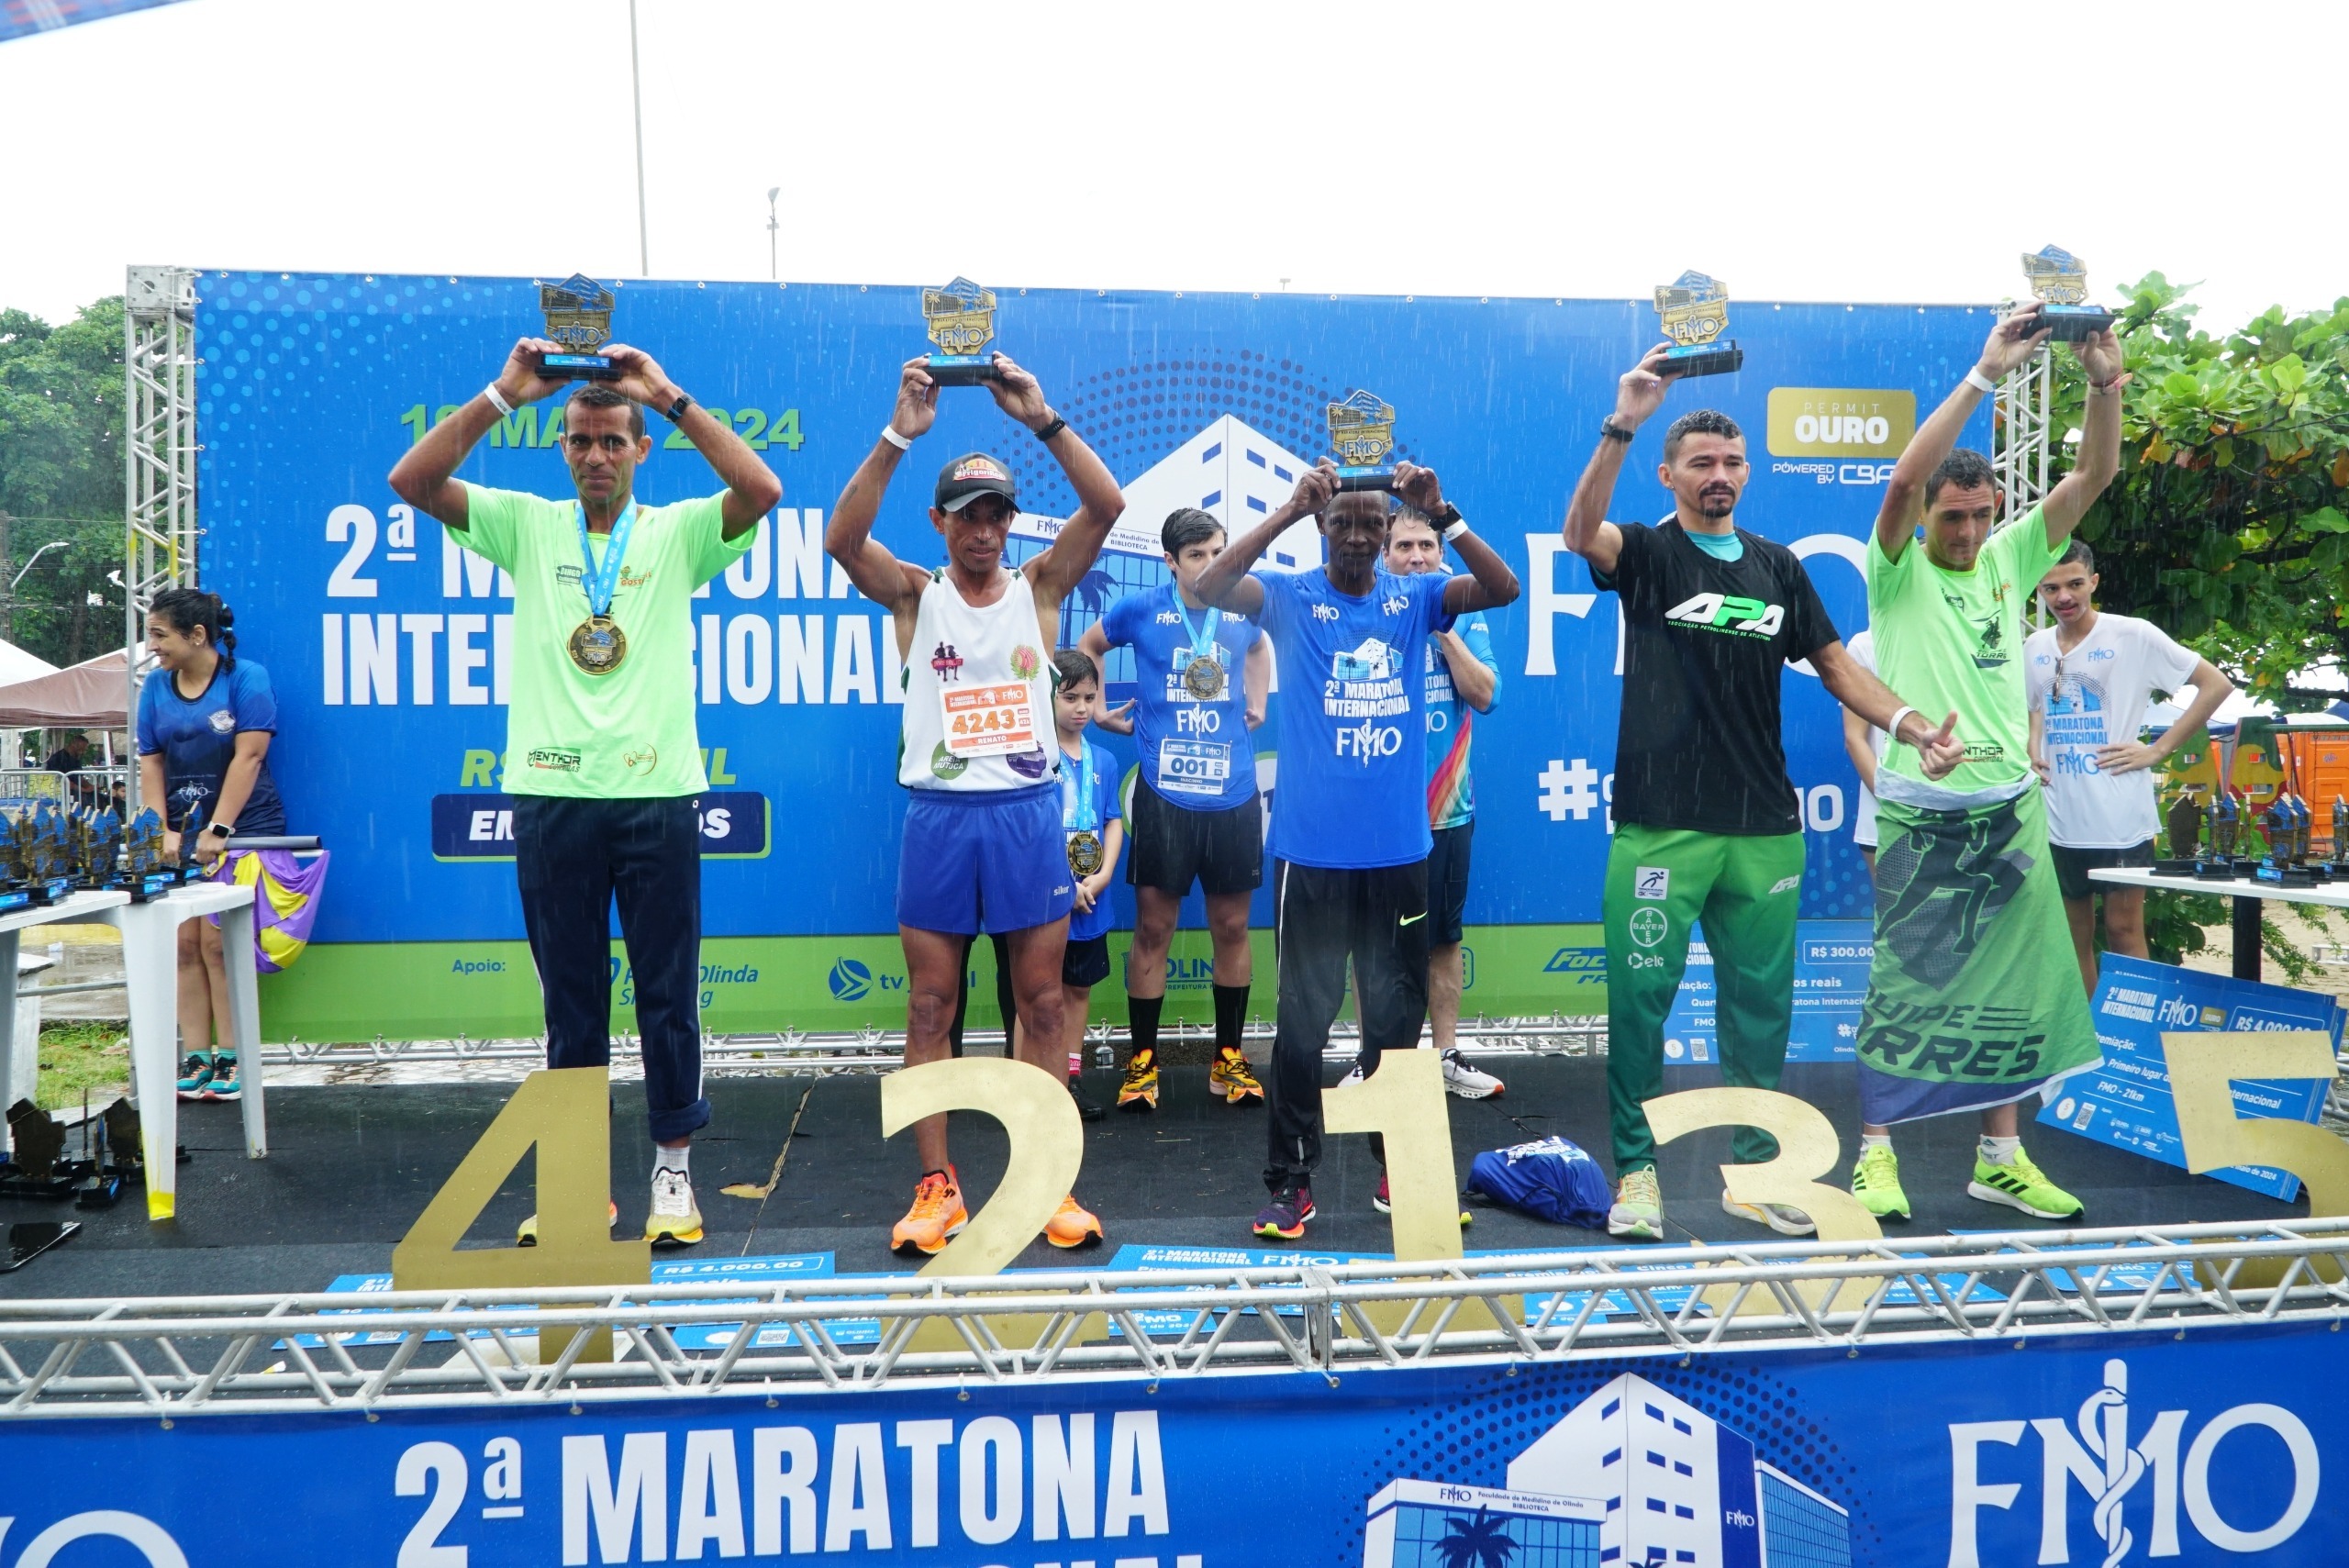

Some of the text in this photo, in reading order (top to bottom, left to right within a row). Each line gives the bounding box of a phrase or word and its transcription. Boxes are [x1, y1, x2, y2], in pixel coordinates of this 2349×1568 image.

[559, 326, 600, 343] FMO
[942, 328, 982, 346] FMO
[1675, 318, 1717, 338] FMO
[1804, 402, 1880, 414] PERMIT
[1795, 415, 1889, 444] OURO
[1345, 440, 1383, 457] FMO
[1773, 462, 1835, 474] POWERED
[1817, 474, 1834, 484] BY
[326, 504, 416, 597] 2ª
[1110, 539, 1148, 550] BIBLIOTECA
[1313, 602, 1340, 624] FMO
[1383, 596, 1409, 617] FMO
[1664, 593, 1785, 636] APA
[1156, 610, 1182, 626] FMO
[323, 613, 905, 706] INTEIONAL
[2088, 647, 2114, 663] FMO
[1166, 674, 1177, 687] 2ª
[1325, 680, 1340, 697] 2ª
[1345, 678, 1404, 700] MARATONA
[1002, 688, 1023, 701] FMO
[1324, 695, 1410, 717] INTERNACIONAL
[952, 709, 1016, 734] 4243
[1176, 704, 1219, 740] FMO
[2054, 717, 2103, 730] MARATONA
[977, 736, 1007, 744] RENATO
[1336, 719, 1402, 765] FMO
[2047, 731, 2109, 745] INTERNACIONAL
[528, 750, 581, 766] MENTHOR
[1206, 746, 1221, 756] FMO
[1171, 758, 1208, 776] 001
[2056, 746, 2099, 780] FMO
[1811, 947, 1874, 959] R$ 300,00
[452, 960, 507, 973] Apoio:
[880, 974, 902, 990] tv
[1810, 977, 1842, 988] reais
[2107, 986, 2157, 1008] 2ª MARATONA
[2101, 1001, 2154, 1023] INTERNACIONAL
[2157, 995, 2198, 1029] FMO
[1694, 1018, 1716, 1027] FMO
[2236, 1016, 2253, 1032] R$
[1861, 1026, 2045, 1076] RRES
[2108, 1058, 2163, 1082] Primeiro lugar
[2097, 1081, 2117, 1095] FMO
[2122, 1086, 2144, 1102] 21km
[2230, 1089, 2283, 1109] nternacional
[2161, 1031, 2349, 1286] 5
[2251, 1166, 2259, 1176] de
[2260, 1170, 2277, 1181] 2024
[1321, 1048, 1525, 1340] 1
[1641, 1087, 1883, 1316] 3
[880, 1057, 1108, 1353] 2
[392, 1066, 651, 1364] 4
[1141, 1254, 1252, 1265] INTERNACIONAL
[1166, 1250, 1247, 1260] MARATONA
[1262, 1253, 1339, 1266] FMO
[663, 1261, 804, 1274] R$ 4.000,00
[1948, 1359, 2320, 1568] FMO
[395, 1409, 1170, 1568] 2ª MARATONA
[1440, 1485, 1472, 1505] FMO
[1478, 1491, 1509, 1500] Faculdade
[1512, 1503, 1549, 1512] BIBLIOTECA
[1727, 1509, 1754, 1528] FMO
